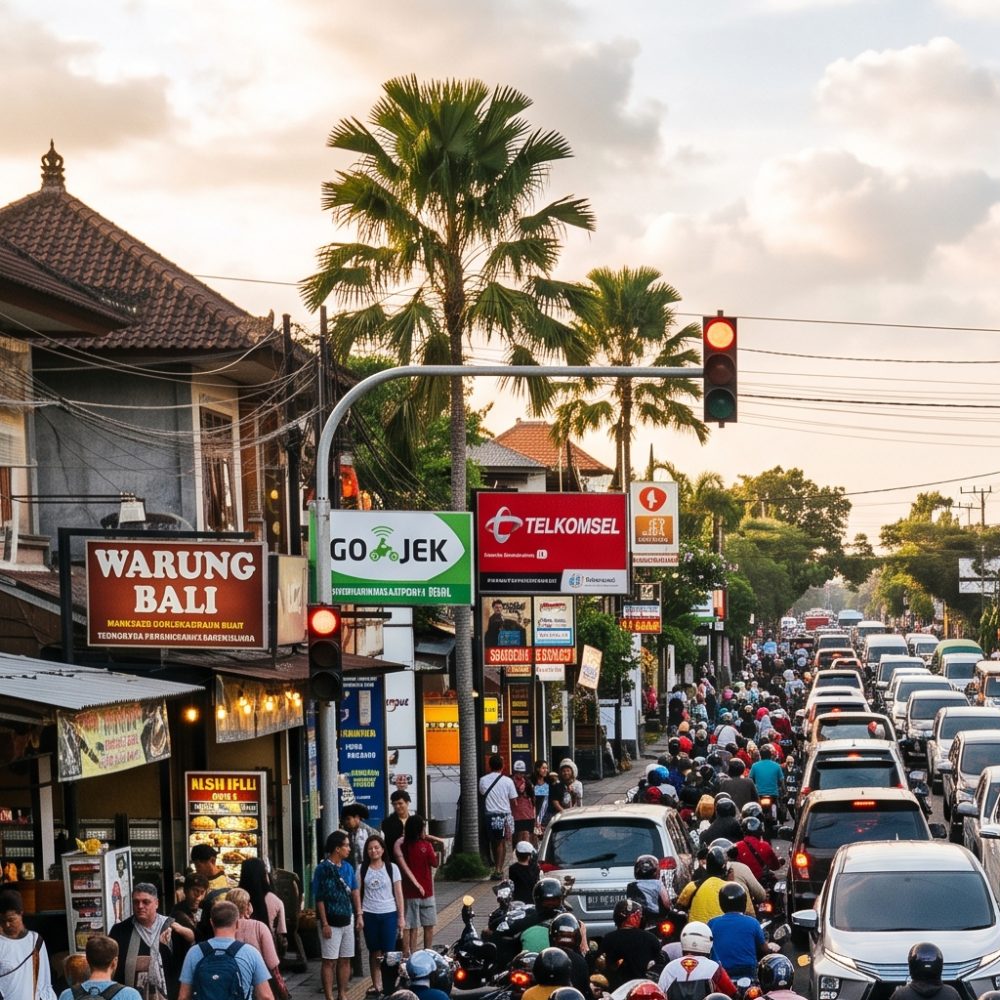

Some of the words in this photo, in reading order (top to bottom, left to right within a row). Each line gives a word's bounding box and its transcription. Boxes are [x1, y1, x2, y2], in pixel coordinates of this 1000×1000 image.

[525, 517, 620, 535] TELKOMSEL
[94, 549, 256, 581] WARUNG
[133, 585, 218, 614] BALI
